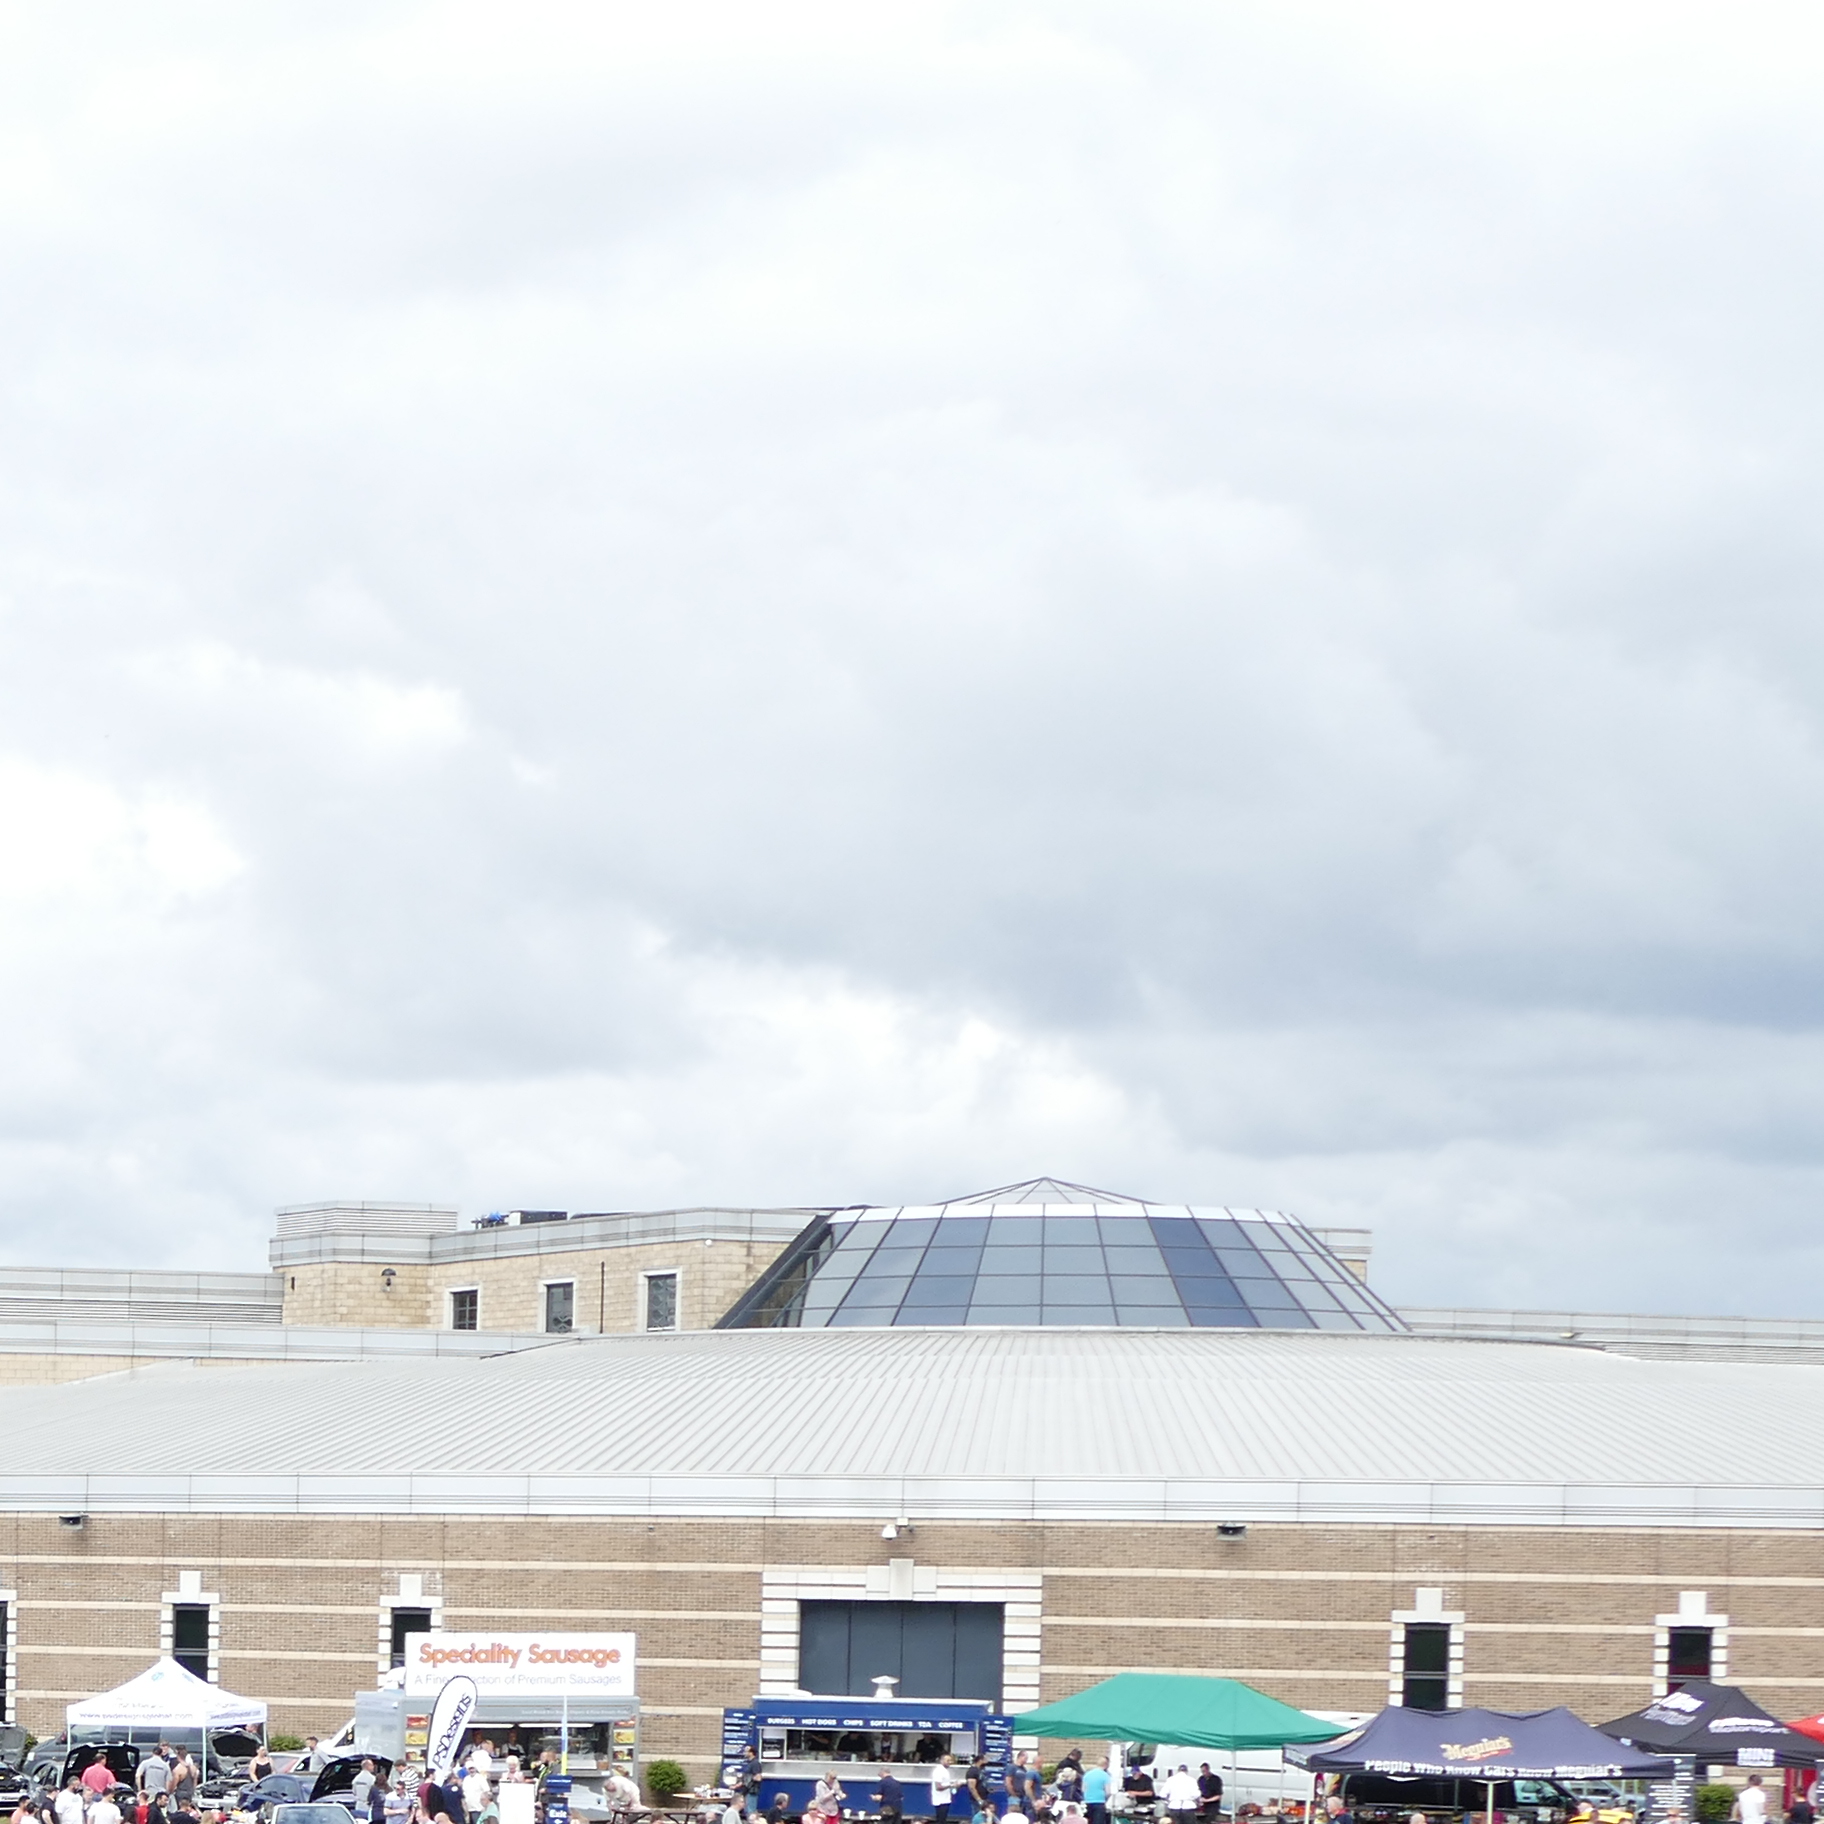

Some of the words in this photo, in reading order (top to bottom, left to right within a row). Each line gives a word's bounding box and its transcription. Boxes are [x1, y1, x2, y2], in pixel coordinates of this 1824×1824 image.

[419, 1643, 523, 1669] Speciality
[528, 1643, 621, 1669] Sausage
[415, 1675, 423, 1685] A
[426, 1674, 446, 1685] Fine
[505, 1673, 516, 1685] of
[518, 1674, 566, 1685] Premium
[569, 1673, 622, 1687] Sausages
[1365, 1760, 1411, 1774] People
[1413, 1763, 1443, 1773] Who
[1445, 1765, 1482, 1775] Know
[1484, 1765, 1516, 1777] Cars
[1554, 1763, 1623, 1779] Meguiar's
[549, 1809, 567, 1818] Exit
